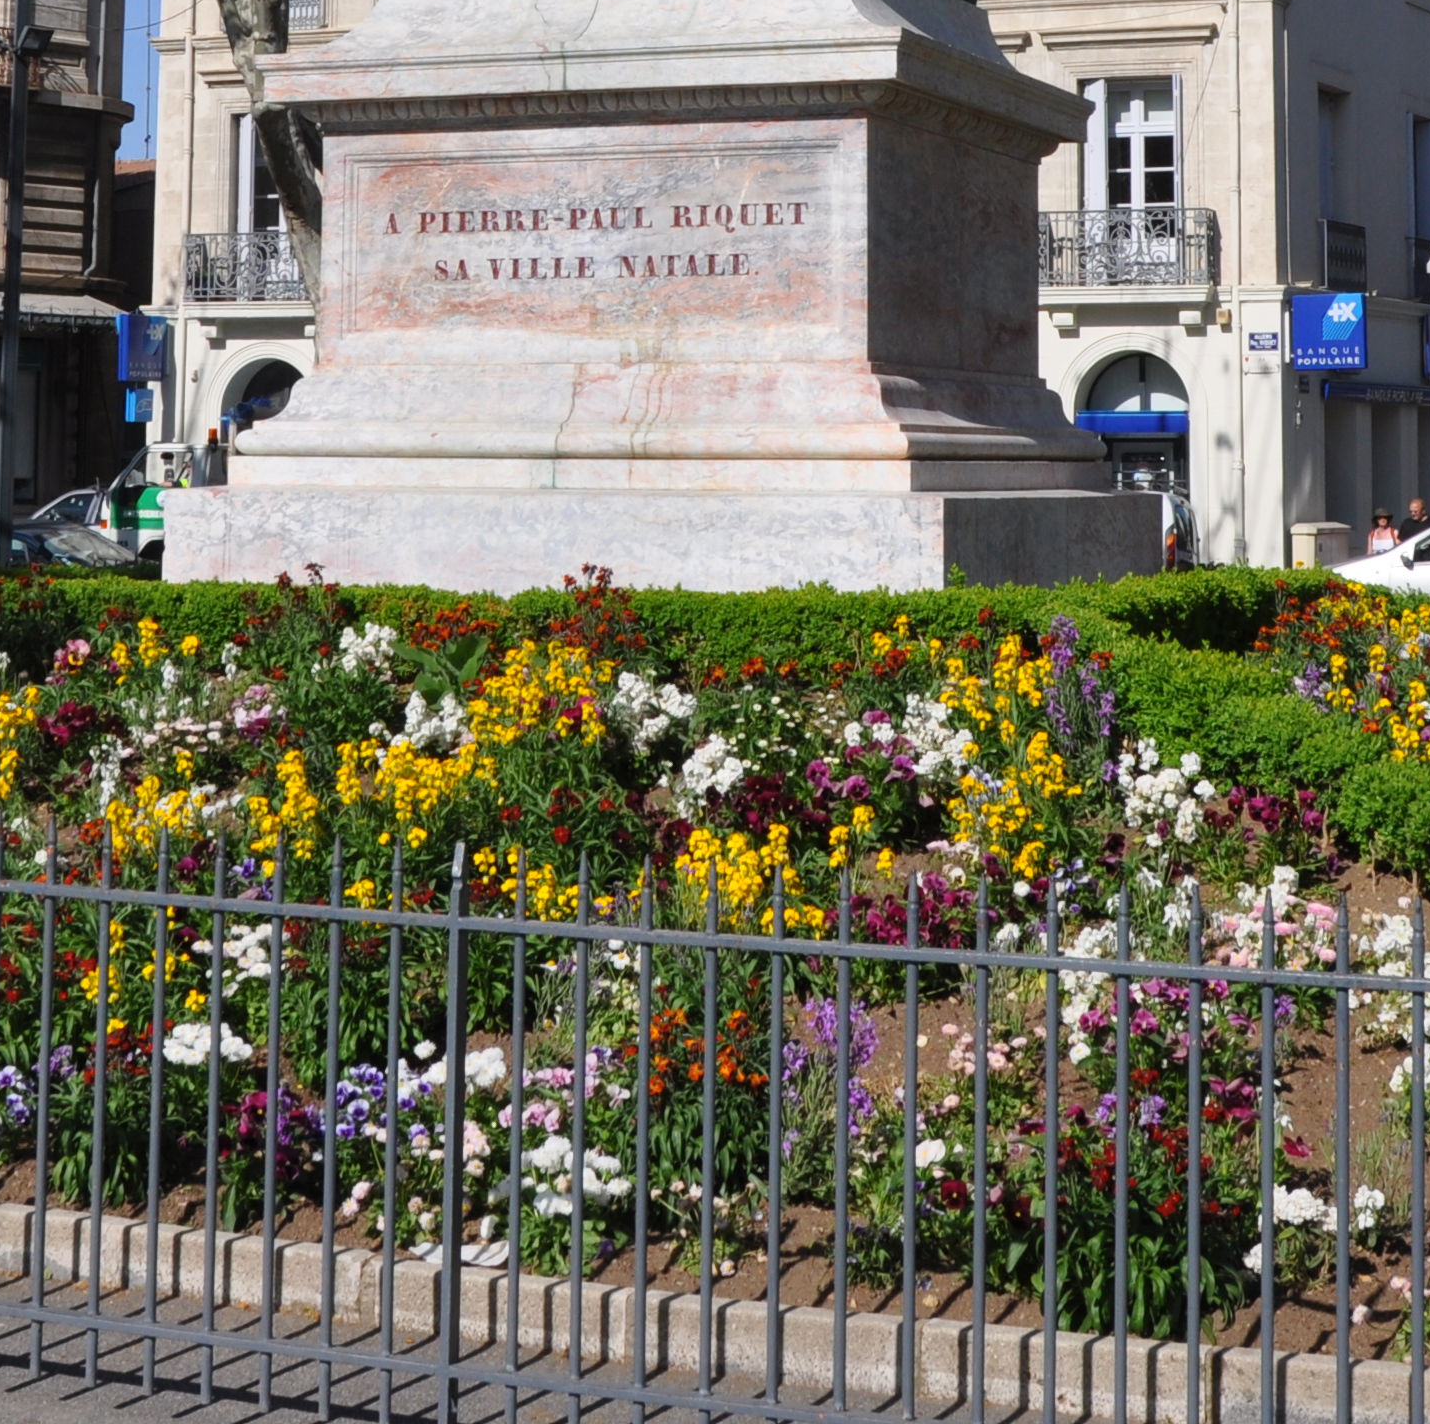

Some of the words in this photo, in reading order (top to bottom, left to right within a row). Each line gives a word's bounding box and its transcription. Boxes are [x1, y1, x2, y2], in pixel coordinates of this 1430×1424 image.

[383, 212, 401, 235] A
[417, 207, 653, 234] PIERRE-PAUL
[670, 202, 809, 233] RIQUET
[434, 258, 470, 281] SA
[486, 256, 595, 280] VILLE
[617, 252, 759, 278] NATALE.
[1297, 346, 1360, 356] BANQUE
[1297, 356, 1360, 366] POPULAIRE
